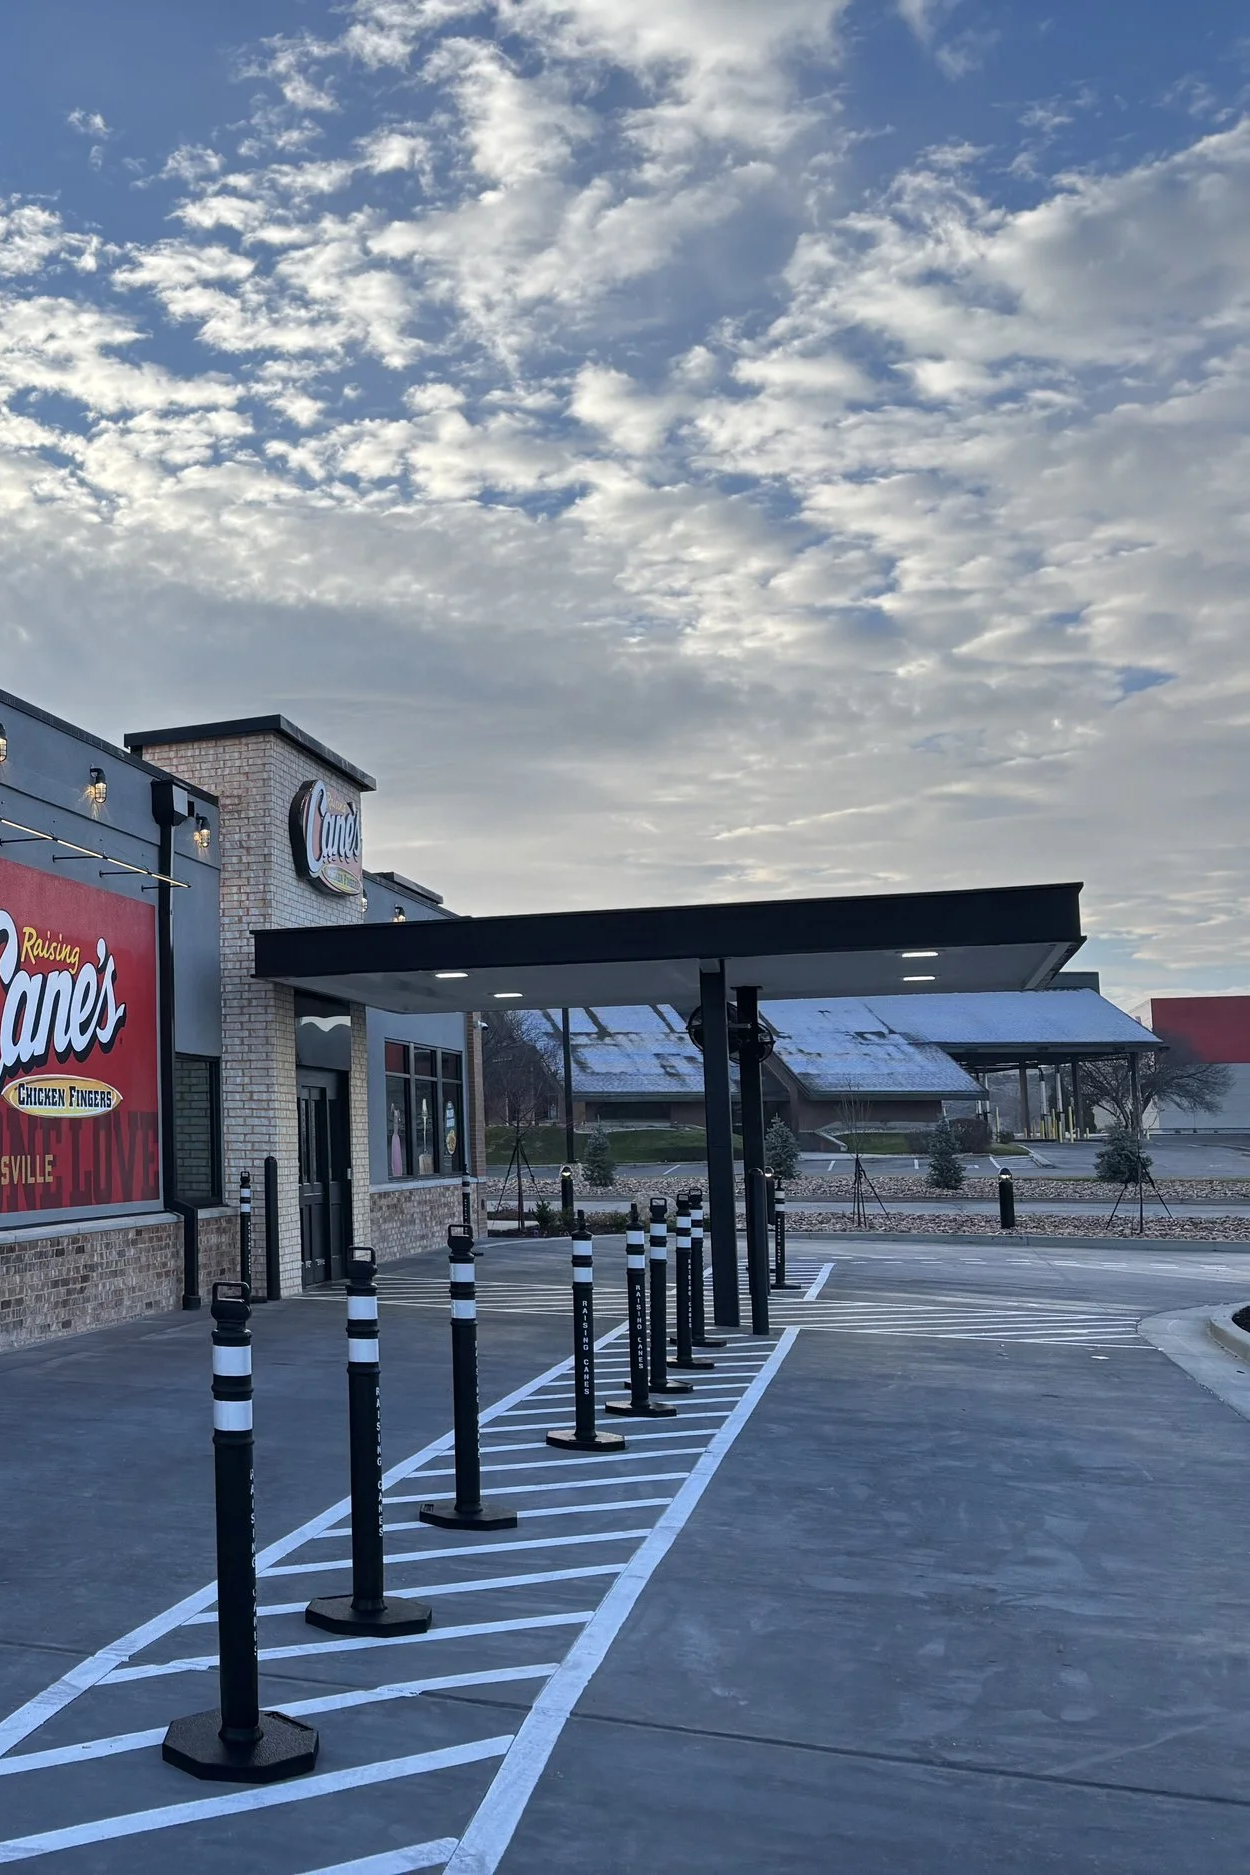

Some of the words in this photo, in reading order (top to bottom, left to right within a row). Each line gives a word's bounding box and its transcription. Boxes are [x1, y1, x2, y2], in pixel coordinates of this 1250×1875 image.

[307, 779, 361, 874] Cane's
[21, 927, 81, 974] Raising
[17, 1083, 66, 1107] CHICKEN
[68, 1086, 113, 1109] FINGERS
[69, 1110, 160, 1205] LOVE
[635, 1284, 643, 1330] RAISING
